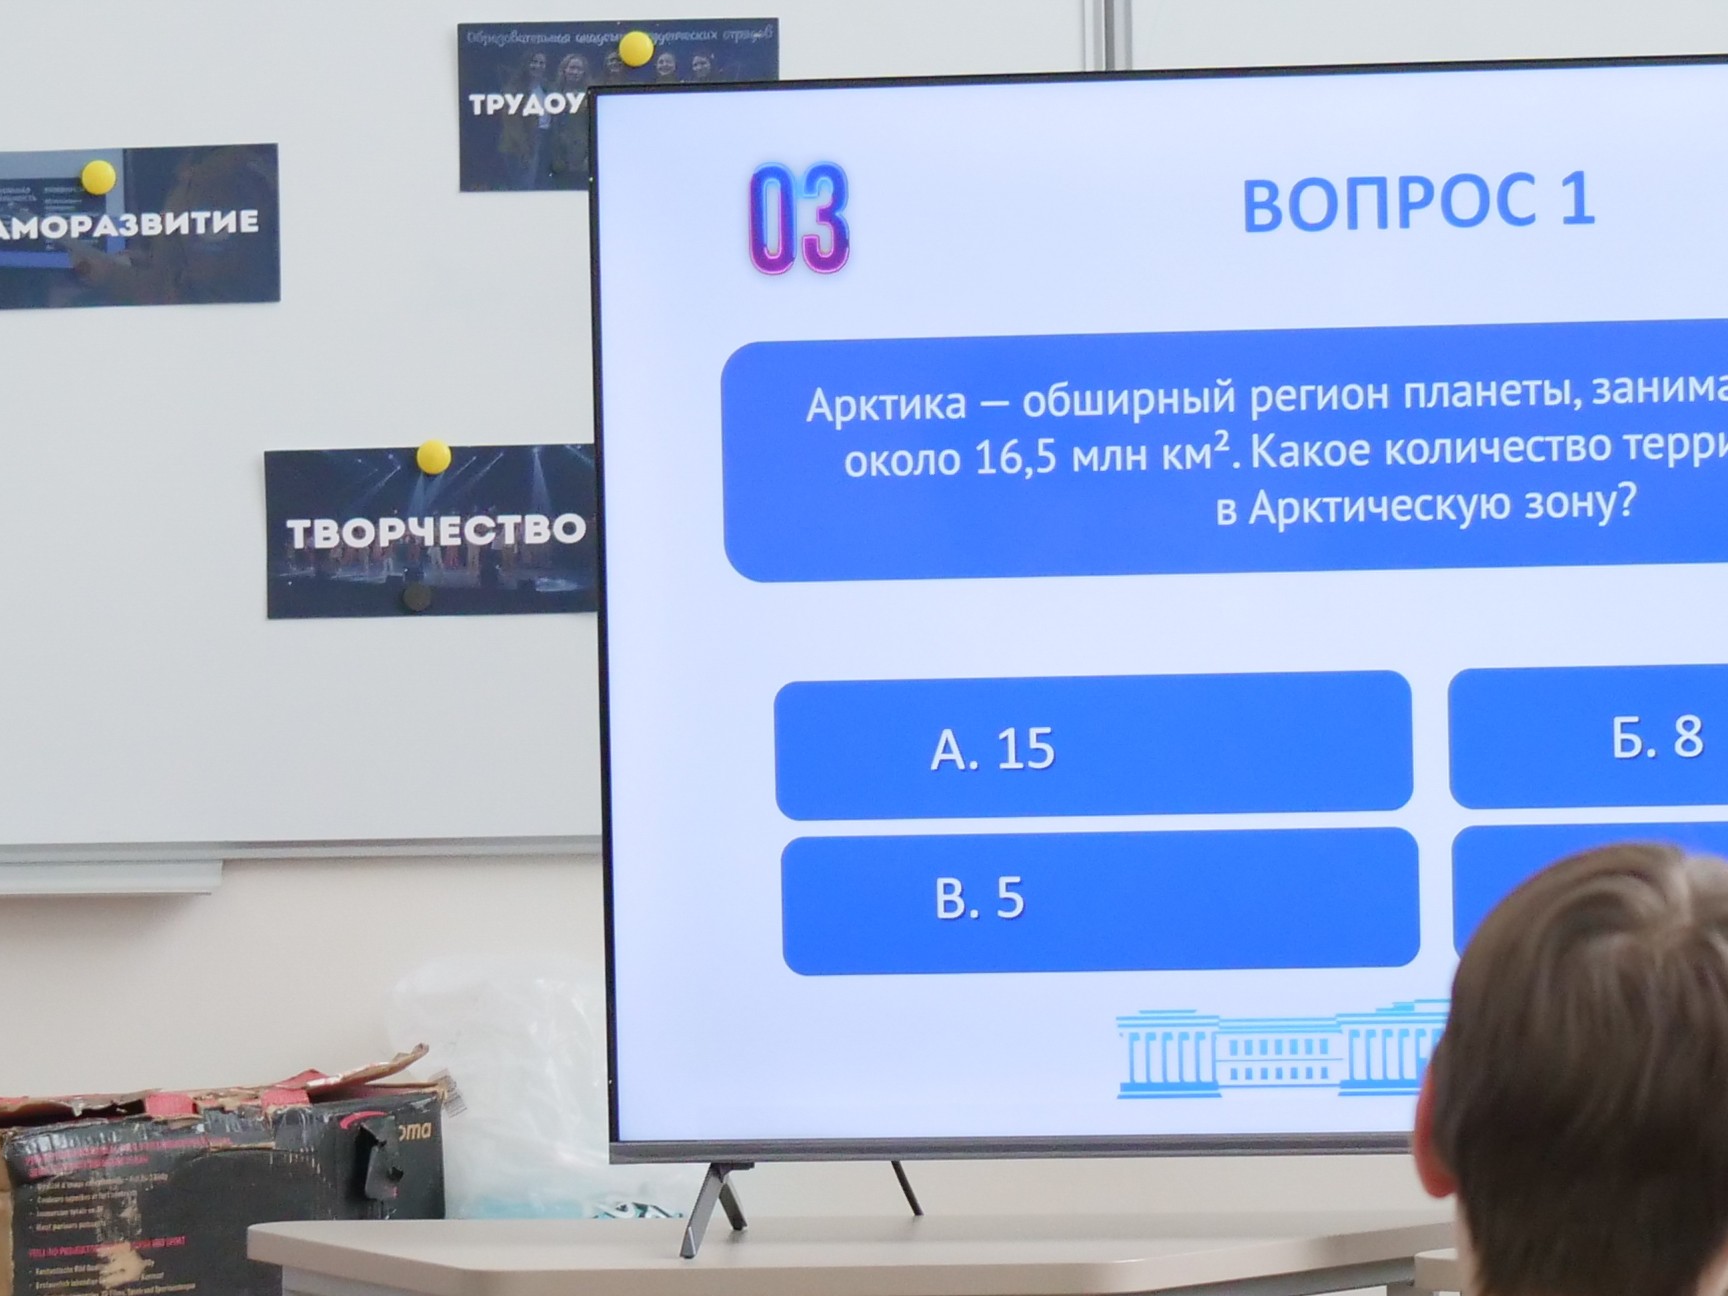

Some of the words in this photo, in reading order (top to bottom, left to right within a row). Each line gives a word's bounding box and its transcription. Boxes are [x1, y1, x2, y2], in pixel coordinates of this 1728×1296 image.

[469, 93, 585, 116] ТРУДОУ
[748, 161, 852, 275] 03
[1245, 172, 1536, 232] ВОПРОС
[1562, 171, 1595, 224] 1
[807, 388, 966, 424] Арктика
[1024, 378, 1235, 420] обширный
[1252, 382, 1389, 415] регион
[1405, 378, 1583, 412] планеты,
[845, 449, 960, 477] около
[976, 438, 1056, 479] 16,5
[1074, 446, 1146, 471] млн
[1253, 433, 1370, 468] Какое
[1386, 435, 1611, 464] количество
[1218, 499, 1237, 525] в
[1249, 490, 1510, 532] Арктическую
[1526, 481, 1637, 526] зону?
[286, 512, 587, 549] ТВОРЧЕСТВО
[931, 729, 977, 770] А.
[999, 727, 1054, 768] 15
[1614, 716, 1655, 758] Б.
[1675, 715, 1703, 758] 8
[937, 878, 978, 919] В.
[998, 876, 1024, 918] 5
